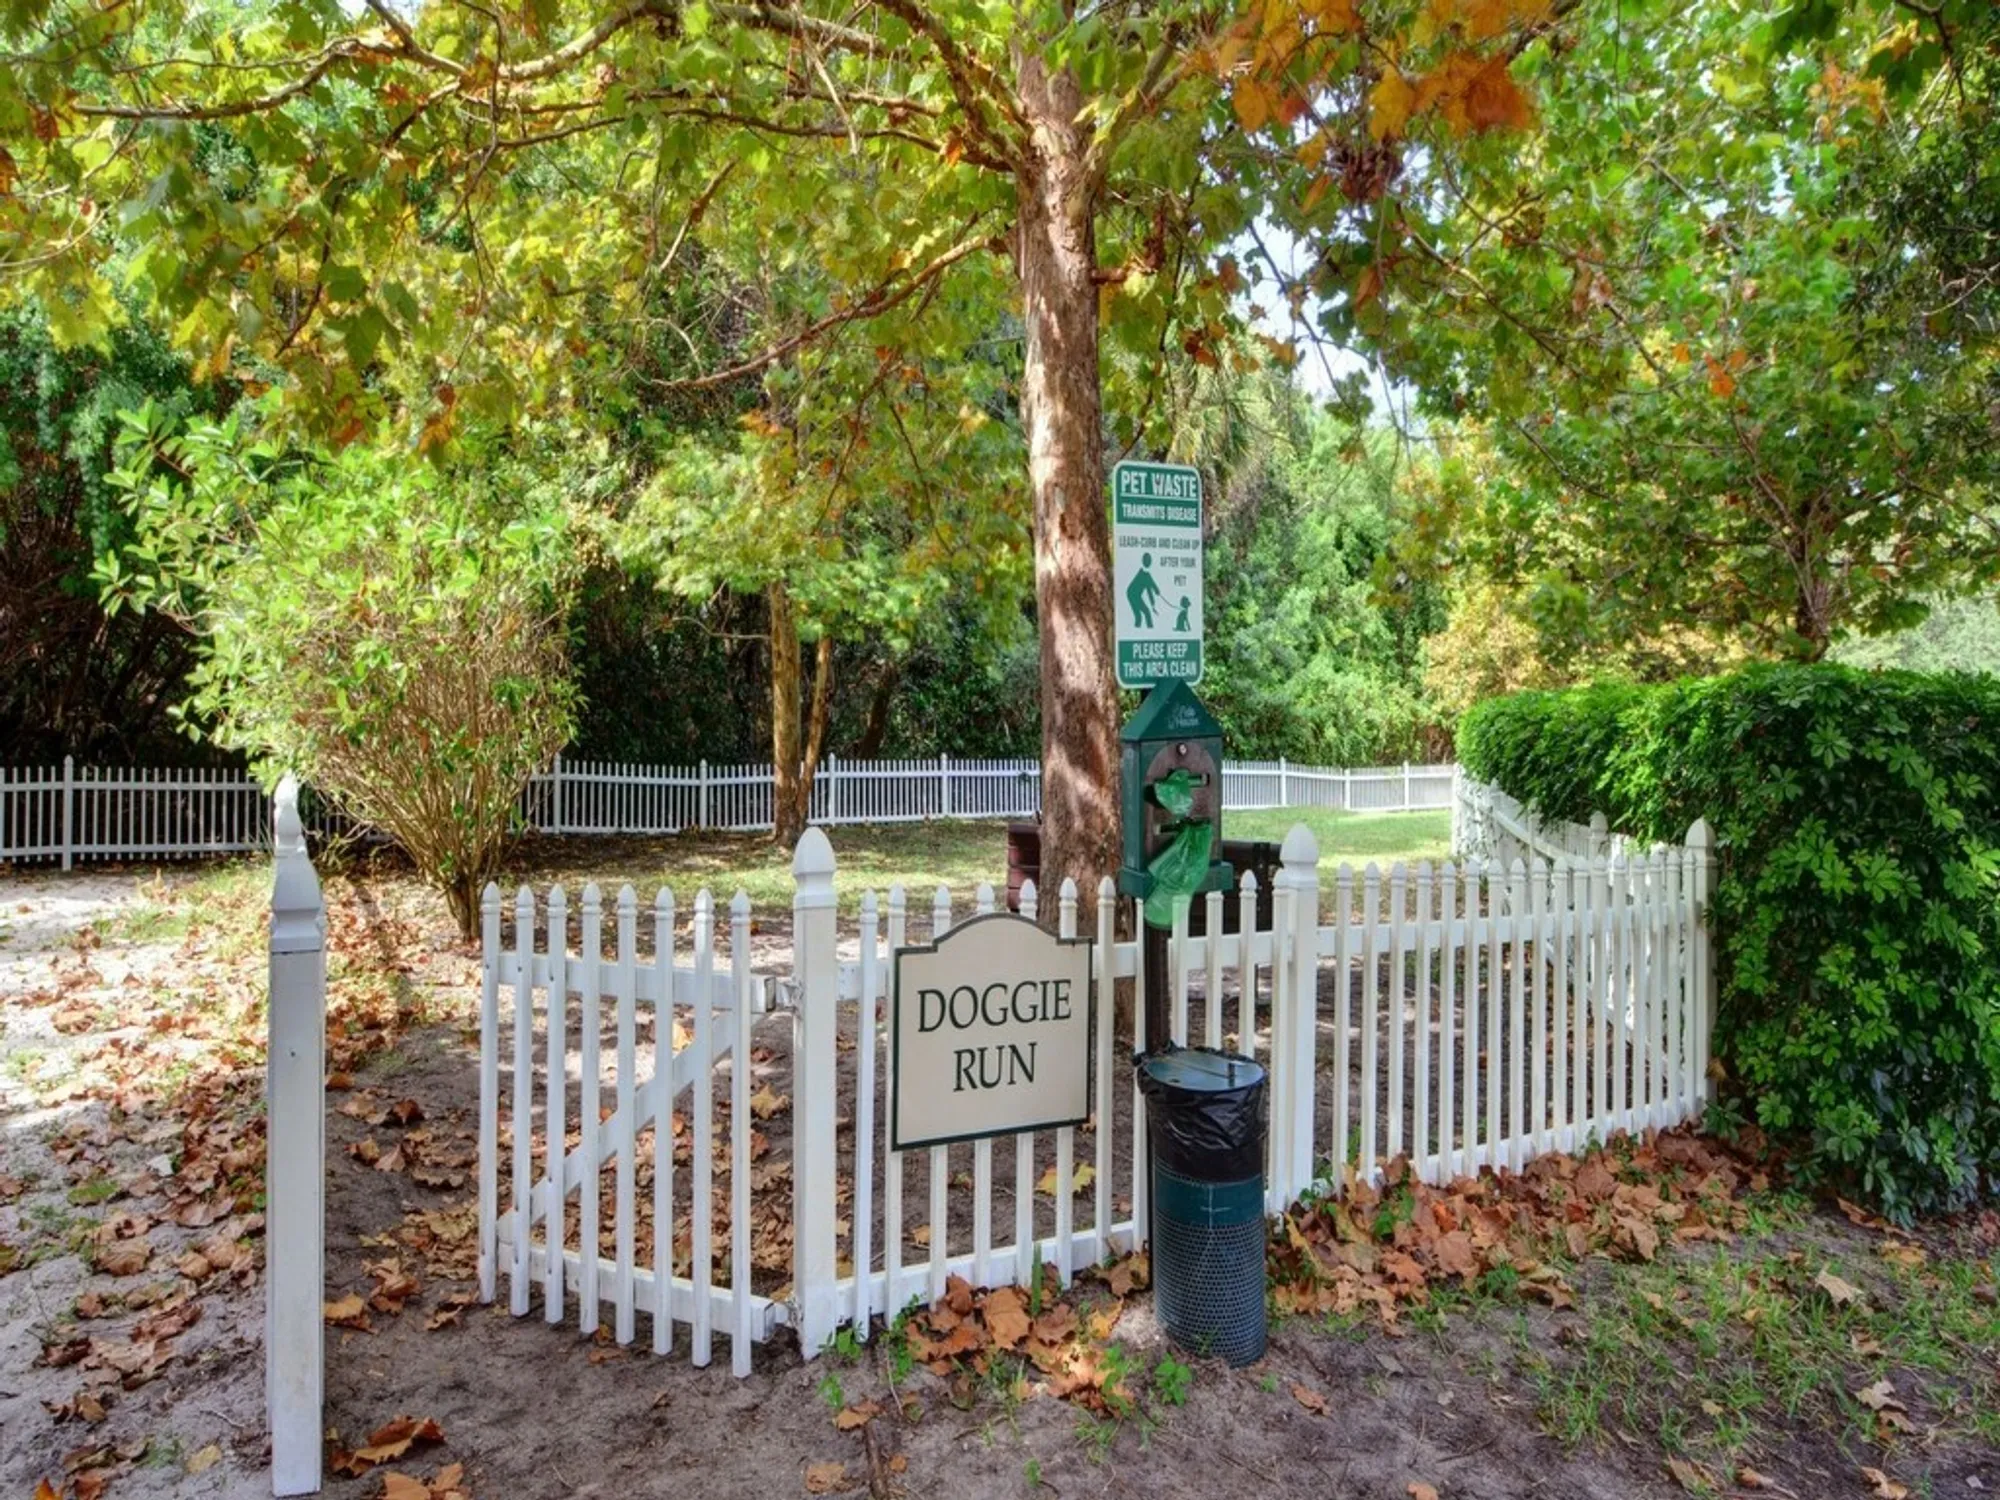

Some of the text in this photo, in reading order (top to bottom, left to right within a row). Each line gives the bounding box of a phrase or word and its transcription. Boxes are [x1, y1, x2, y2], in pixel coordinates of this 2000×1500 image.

[1121, 471, 1197, 497] PET WASTE
[1167, 505, 1197, 521] DISEASE
[1172, 538, 1190, 550] CLEAN
[1192, 539, 1200, 550] UP
[1160, 556, 1196, 568] AFTER YOUR
[1174, 575, 1187, 587] PET
[1132, 643, 1188, 659] PLEASE KEEP
[1123, 661, 1197, 678] THIS AREA CLEAN
[918, 979, 1072, 1033] DOGGIE
[953, 1042, 1037, 1092] RUN
